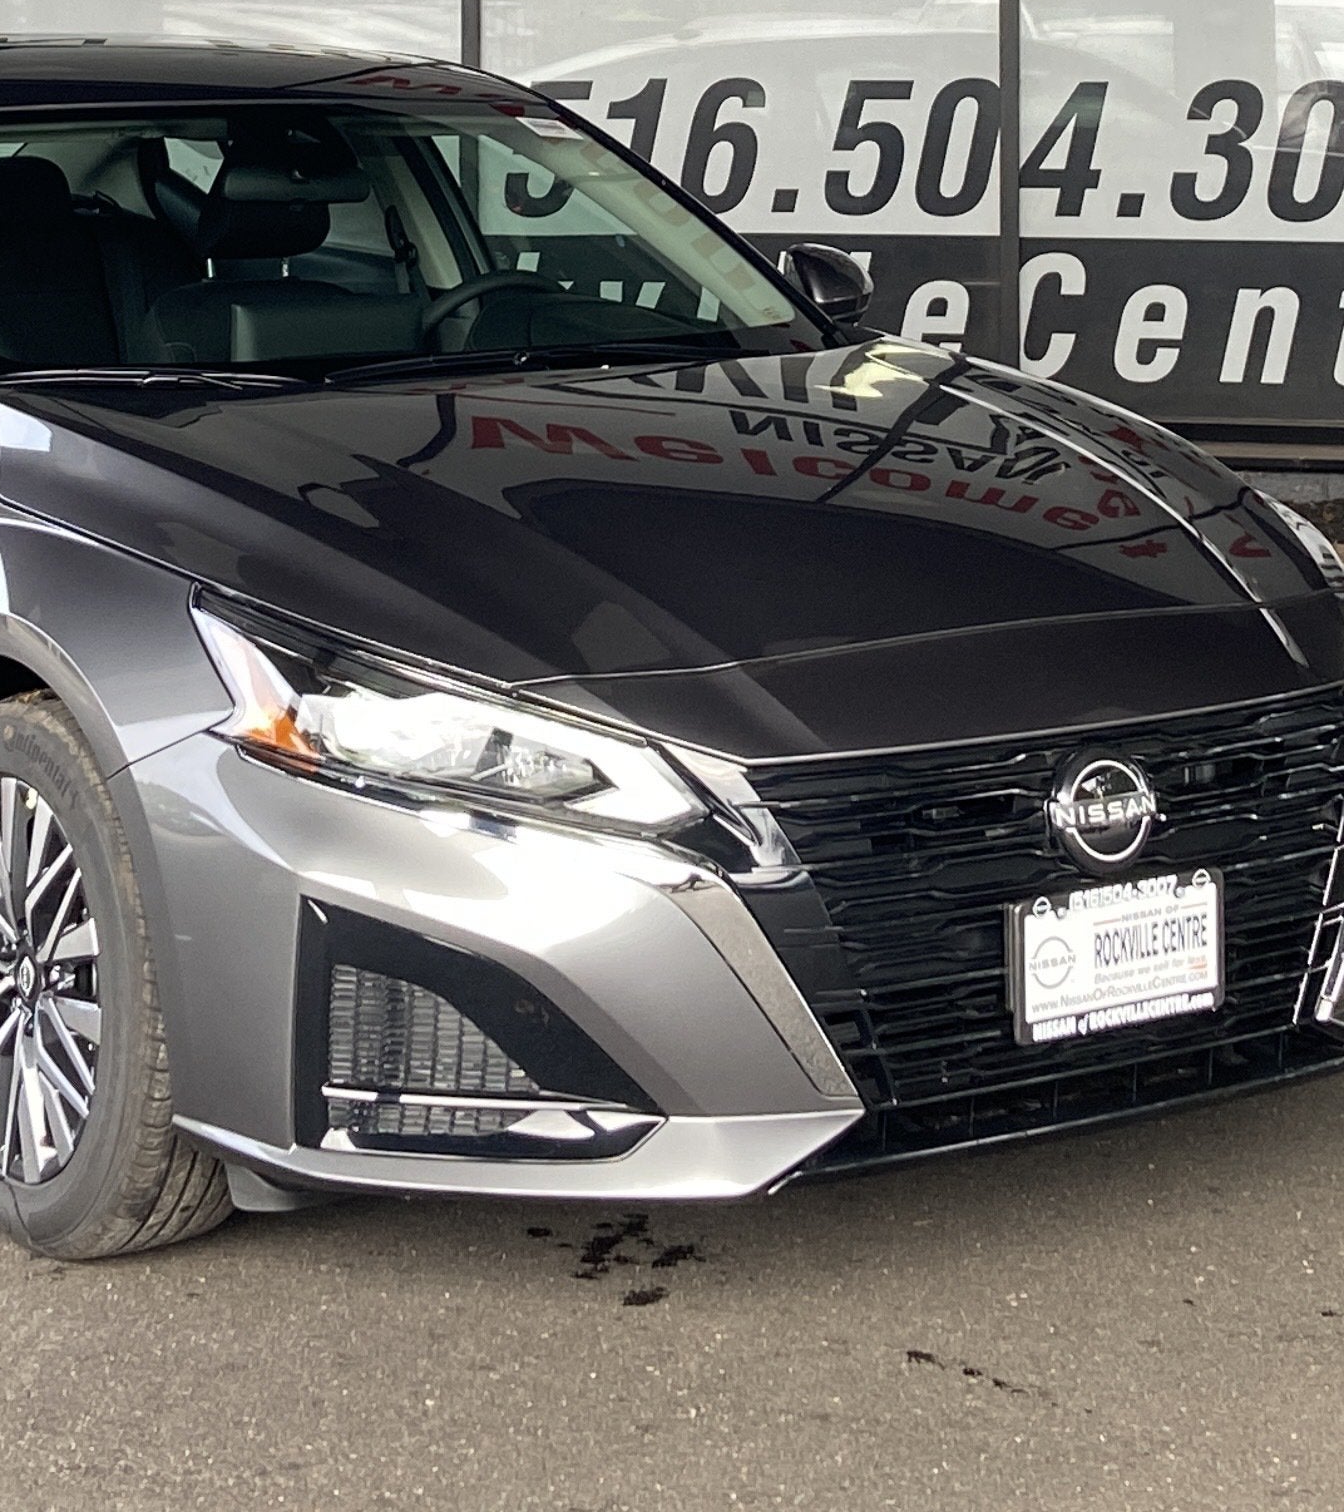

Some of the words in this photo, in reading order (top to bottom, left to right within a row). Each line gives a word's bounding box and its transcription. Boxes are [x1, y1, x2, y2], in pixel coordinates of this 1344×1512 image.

[1056, 793, 1156, 828] NISSAN
[1121, 908, 1162, 922] NISSAN
[1094, 922, 1157, 969] ROCKVILLE
[1161, 915, 1208, 954] CENTRE
[1029, 954, 1076, 971] NISSAN
